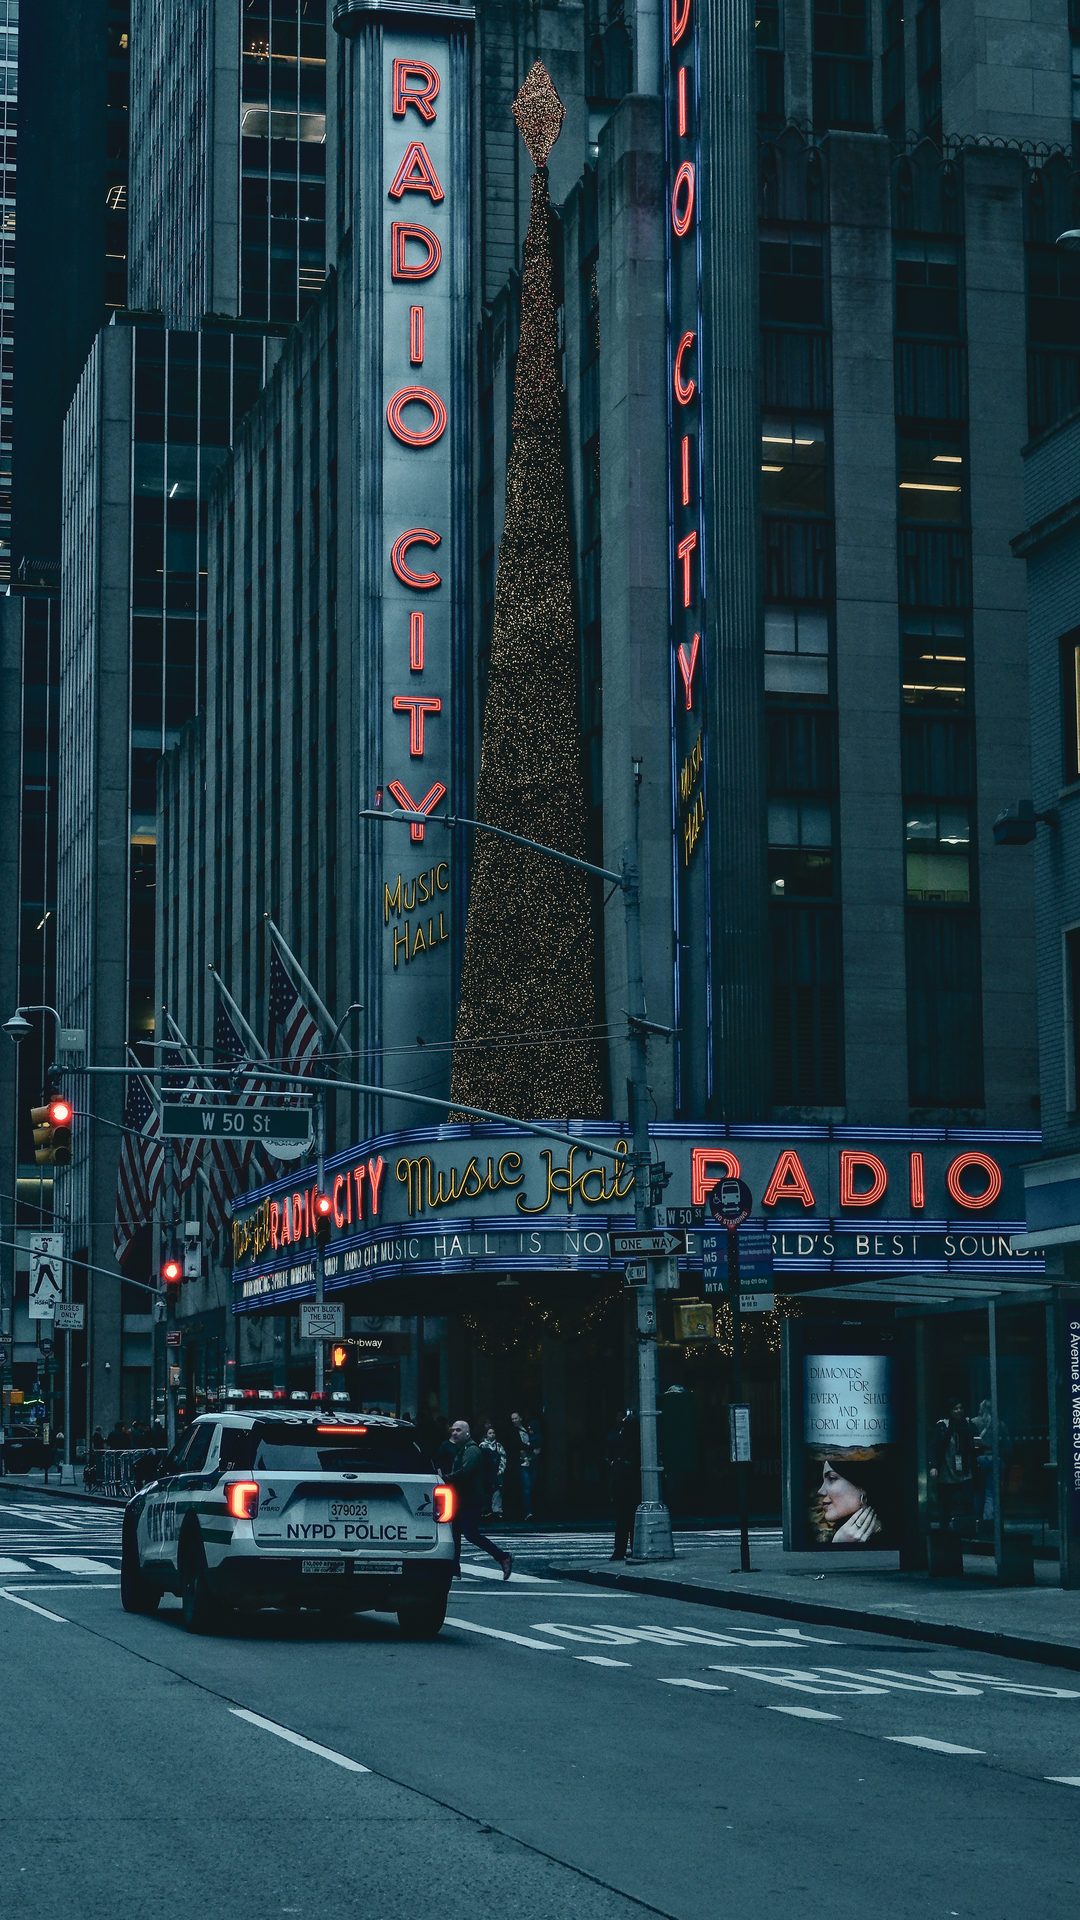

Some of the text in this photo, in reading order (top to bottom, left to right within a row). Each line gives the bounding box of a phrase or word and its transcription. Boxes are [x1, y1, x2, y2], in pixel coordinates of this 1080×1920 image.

[387, 57, 447, 449] RADIO
[675, 331, 700, 711] CITY
[388, 527, 447, 843] CITY
[384, 861, 449, 925] MUSIC
[393, 911, 449, 967] HALL
[202, 1112, 271, 1133] W 50 St
[395, 1140, 635, 1217] Music Hal
[690, 1147, 1003, 1209] RADIO
[333, 1155, 384, 1229] CITY
[667, 1210, 676, 1224] W
[679, 1210, 692, 1224] 50
[714, 1210, 748, 1225] NO STANDING
[380, 1238, 419, 1262] MUSIC
[434, 1233, 496, 1257] HALL
[520, 1232, 542, 1254] IS
[565, 1232, 609, 1254] NO
[856, 1235, 922, 1256] BEST
[620, 1240, 642, 1250] ONE
[652, 1238, 674, 1248] WAY
[703, 1236, 717, 1248] M5
[704, 1252, 718, 1263] M5
[704, 1266, 718, 1278] M7
[705, 1282, 724, 1292] MTA
[1070, 1322, 1080, 1330] 6
[347, 1338, 383, 1348] Subway
[1070, 1333, 1080, 1381] Avenue
[810, 1367, 862, 1379] DIAMONDS
[849, 1381, 870, 1392] FOR
[1072, 1384, 1080, 1394] &
[810, 1393, 840, 1404] EVERY
[839, 1406, 858, 1418] AND
[1072, 1397, 1080, 1430] West
[811, 1418, 888, 1430] FORM OF LOVE
[331, 1504, 368, 1516] 379023
[287, 1524, 408, 1540] NYPD POLICE
[529, 1622, 847, 1647] ONLY
[707, 1665, 1080, 1698] BUS
